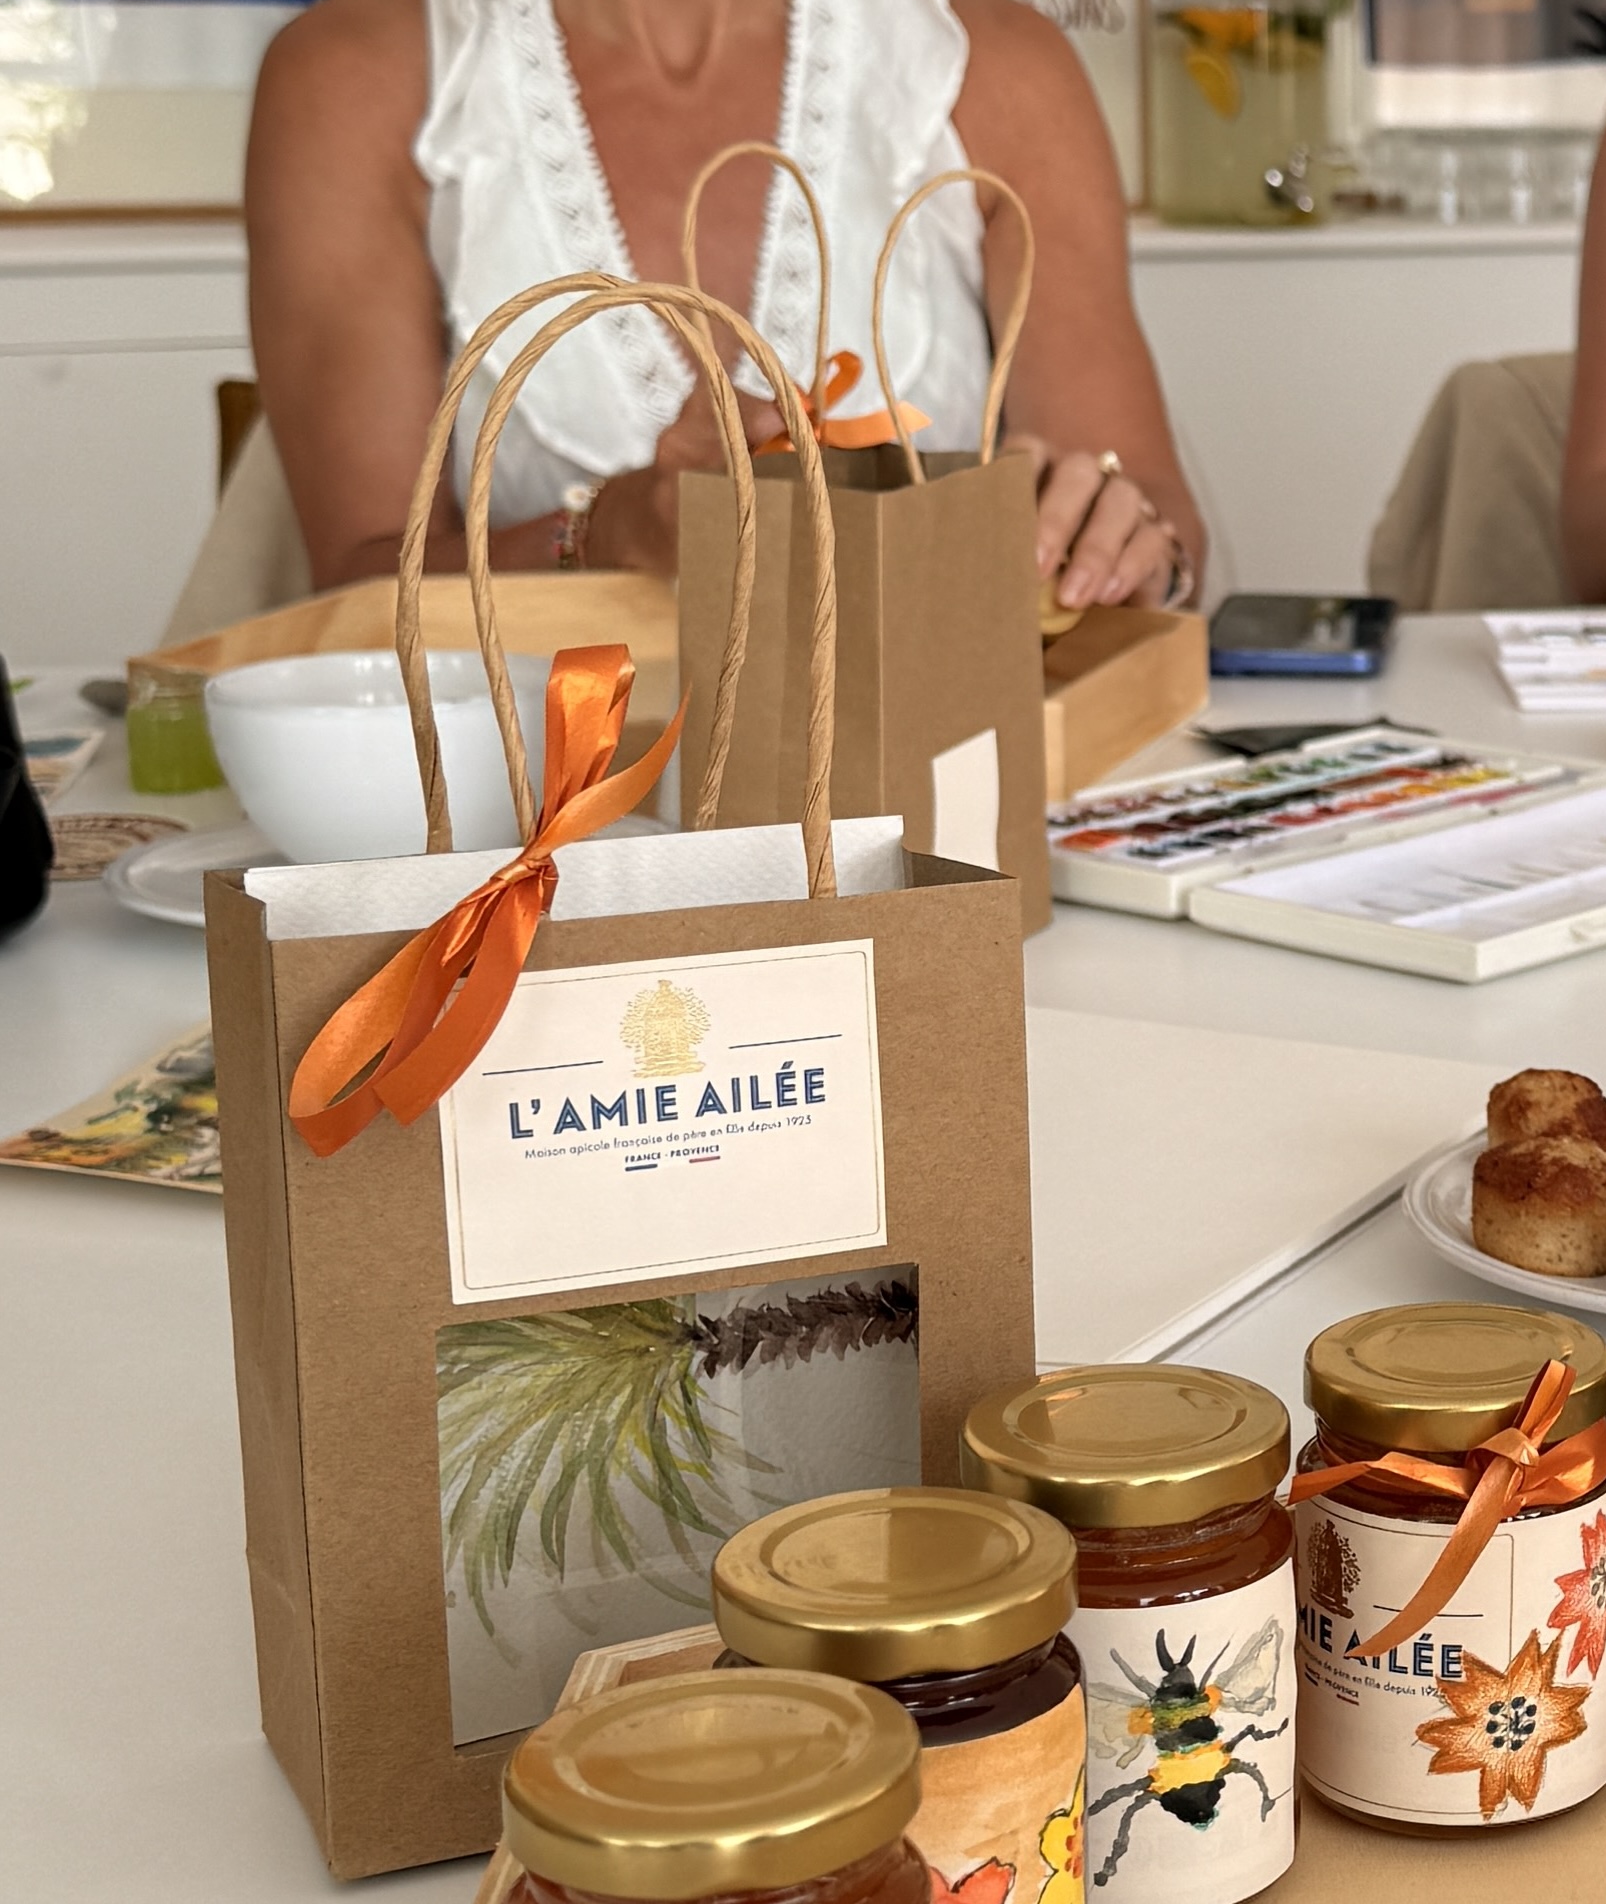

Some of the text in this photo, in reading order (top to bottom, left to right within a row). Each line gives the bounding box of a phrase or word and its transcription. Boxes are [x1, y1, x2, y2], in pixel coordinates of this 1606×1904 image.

[508, 1060, 827, 1140] L'AMIE AILÉE
[524, 1147, 567, 1160] Maison
[570, 1140, 611, 1156] apicole
[613, 1135, 663, 1149] française
[666, 1130, 680, 1143] de
[683, 1129, 707, 1145] père
[710, 1127, 723, 1137] en
[748, 1120, 782, 1133] depuis
[624, 1145, 720, 1164] FRANCE PROVENCE
